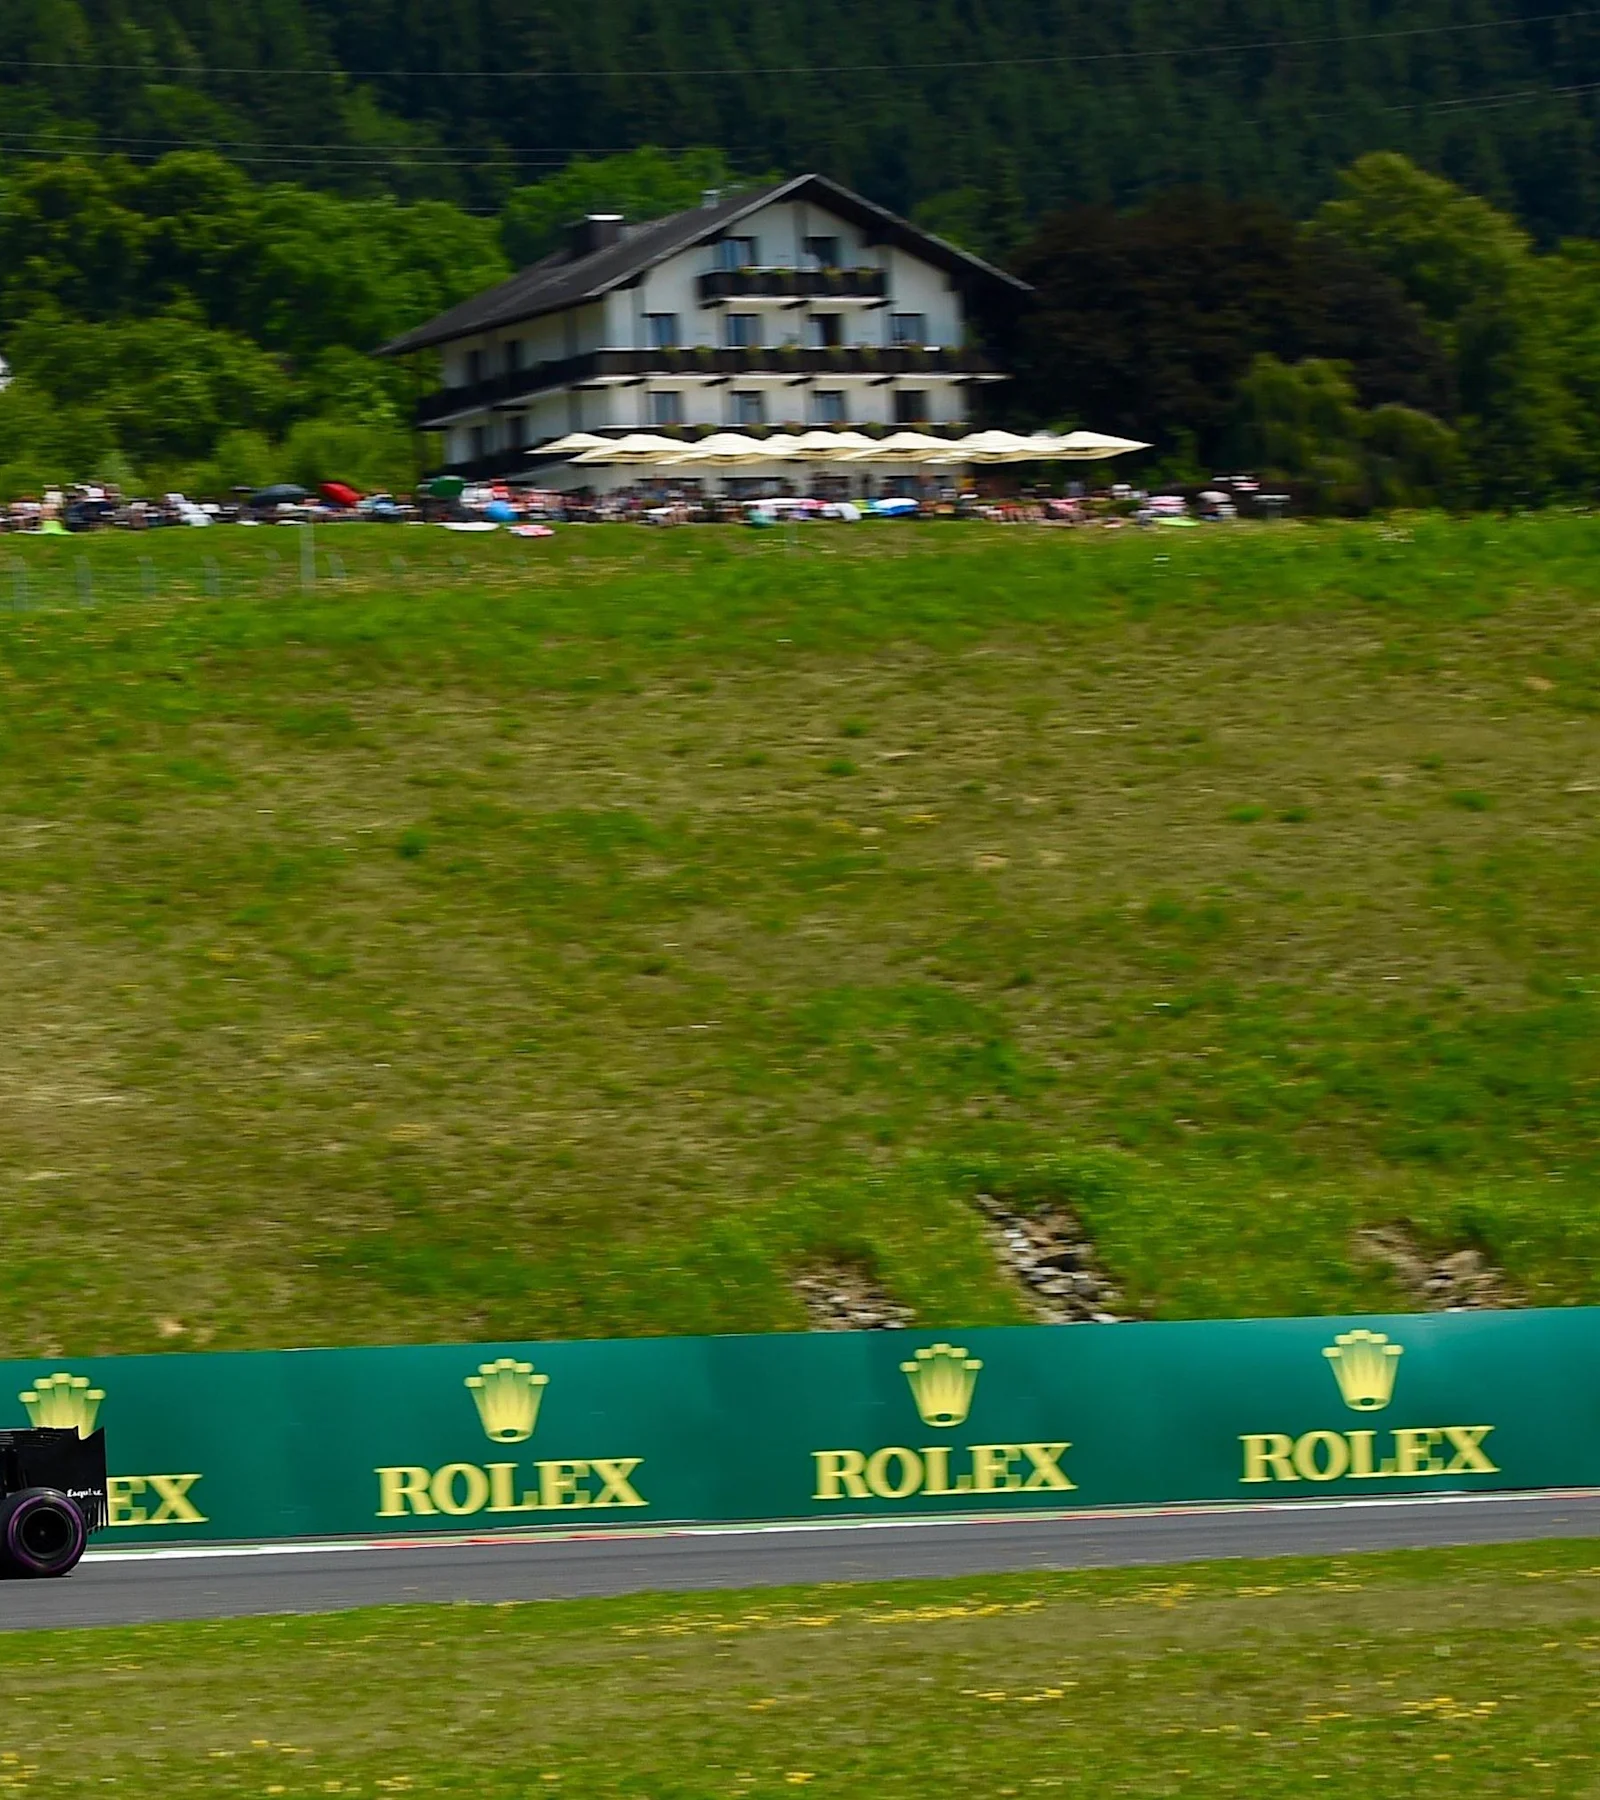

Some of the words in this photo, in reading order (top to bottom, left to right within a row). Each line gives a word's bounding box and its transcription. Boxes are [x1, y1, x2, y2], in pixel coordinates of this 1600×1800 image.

[810, 1442, 1079, 1500] ROLEX
[1235, 1425, 1501, 1483] ROLEX
[66, 1488, 103, 1499] Esquire
[373, 1457, 650, 1517] ROLEX
